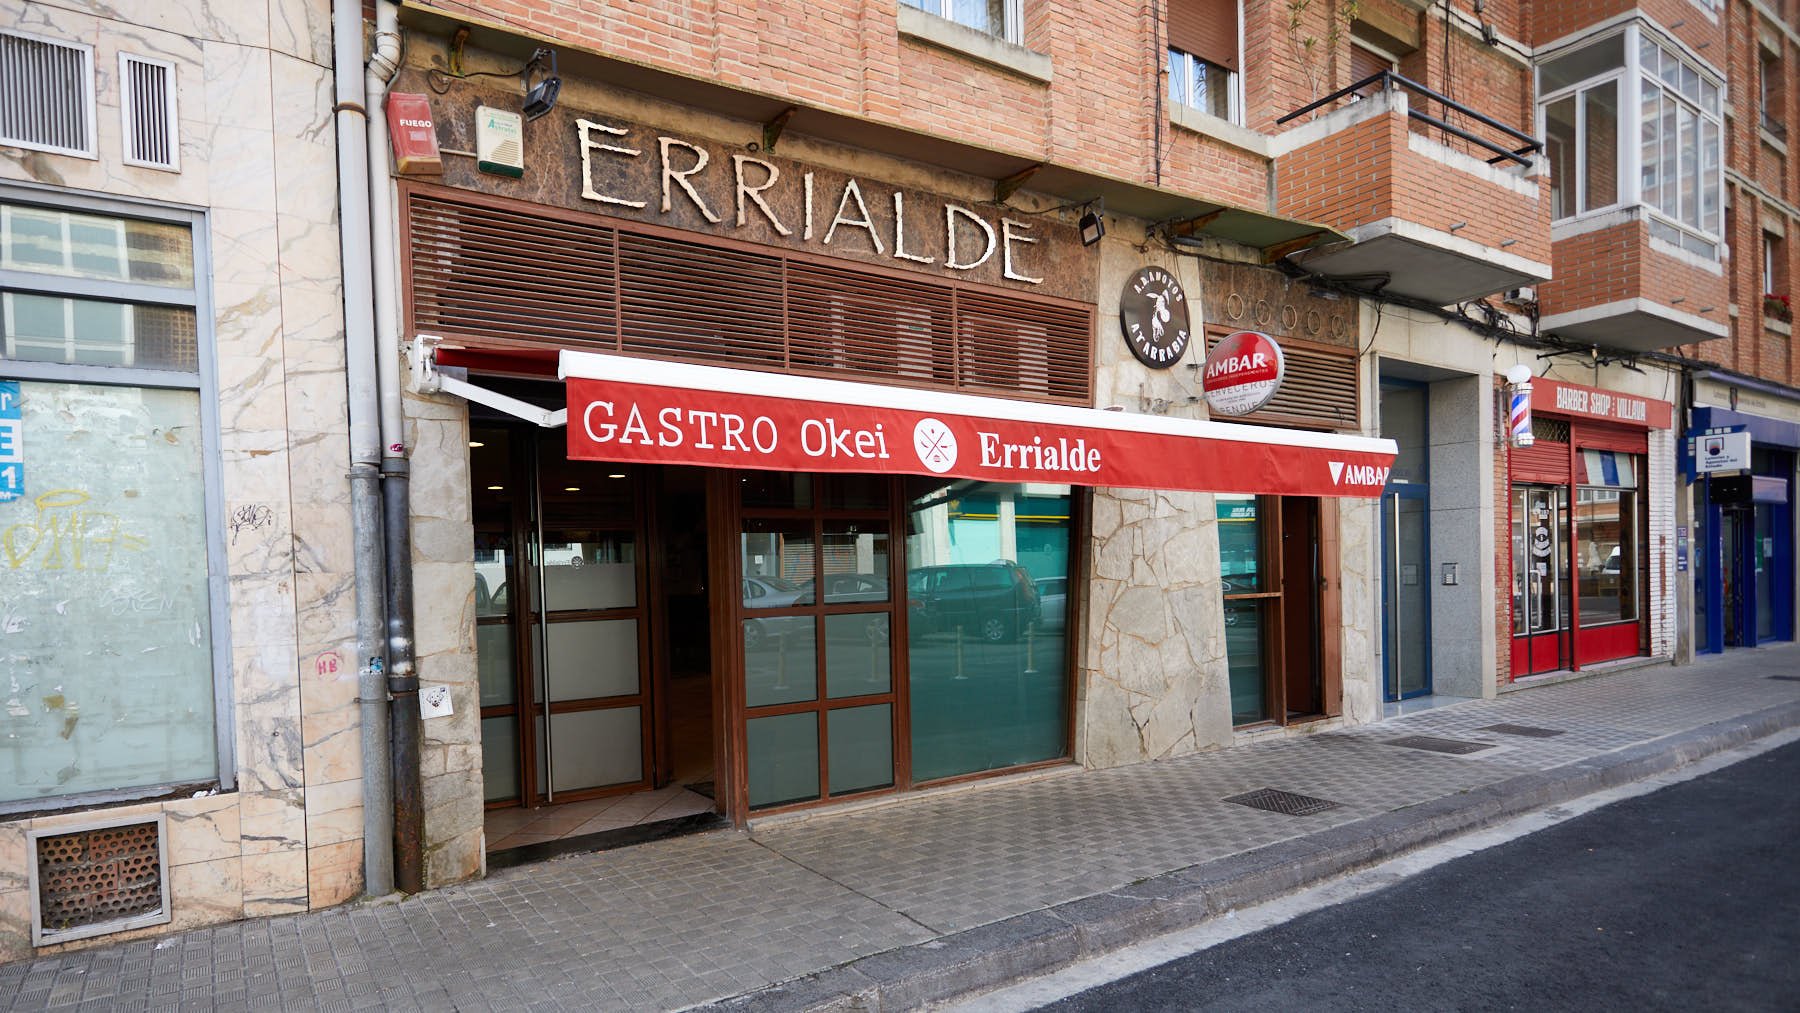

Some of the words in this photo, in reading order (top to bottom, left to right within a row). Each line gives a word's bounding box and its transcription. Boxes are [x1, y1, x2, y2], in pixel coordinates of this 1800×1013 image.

[399, 118, 433, 128] FUEGO
[575, 118, 1044, 284] ERRIALDE
[1206, 352, 1268, 379] AMBAR
[1556, 386, 1588, 413] BARBER
[1590, 392, 1611, 416] SHOP
[1617, 397, 1646, 421] VILLAVA
[583, 400, 778, 454] GASTRO
[800, 417, 890, 459] Okei
[976, 431, 1101, 473] Errialde
